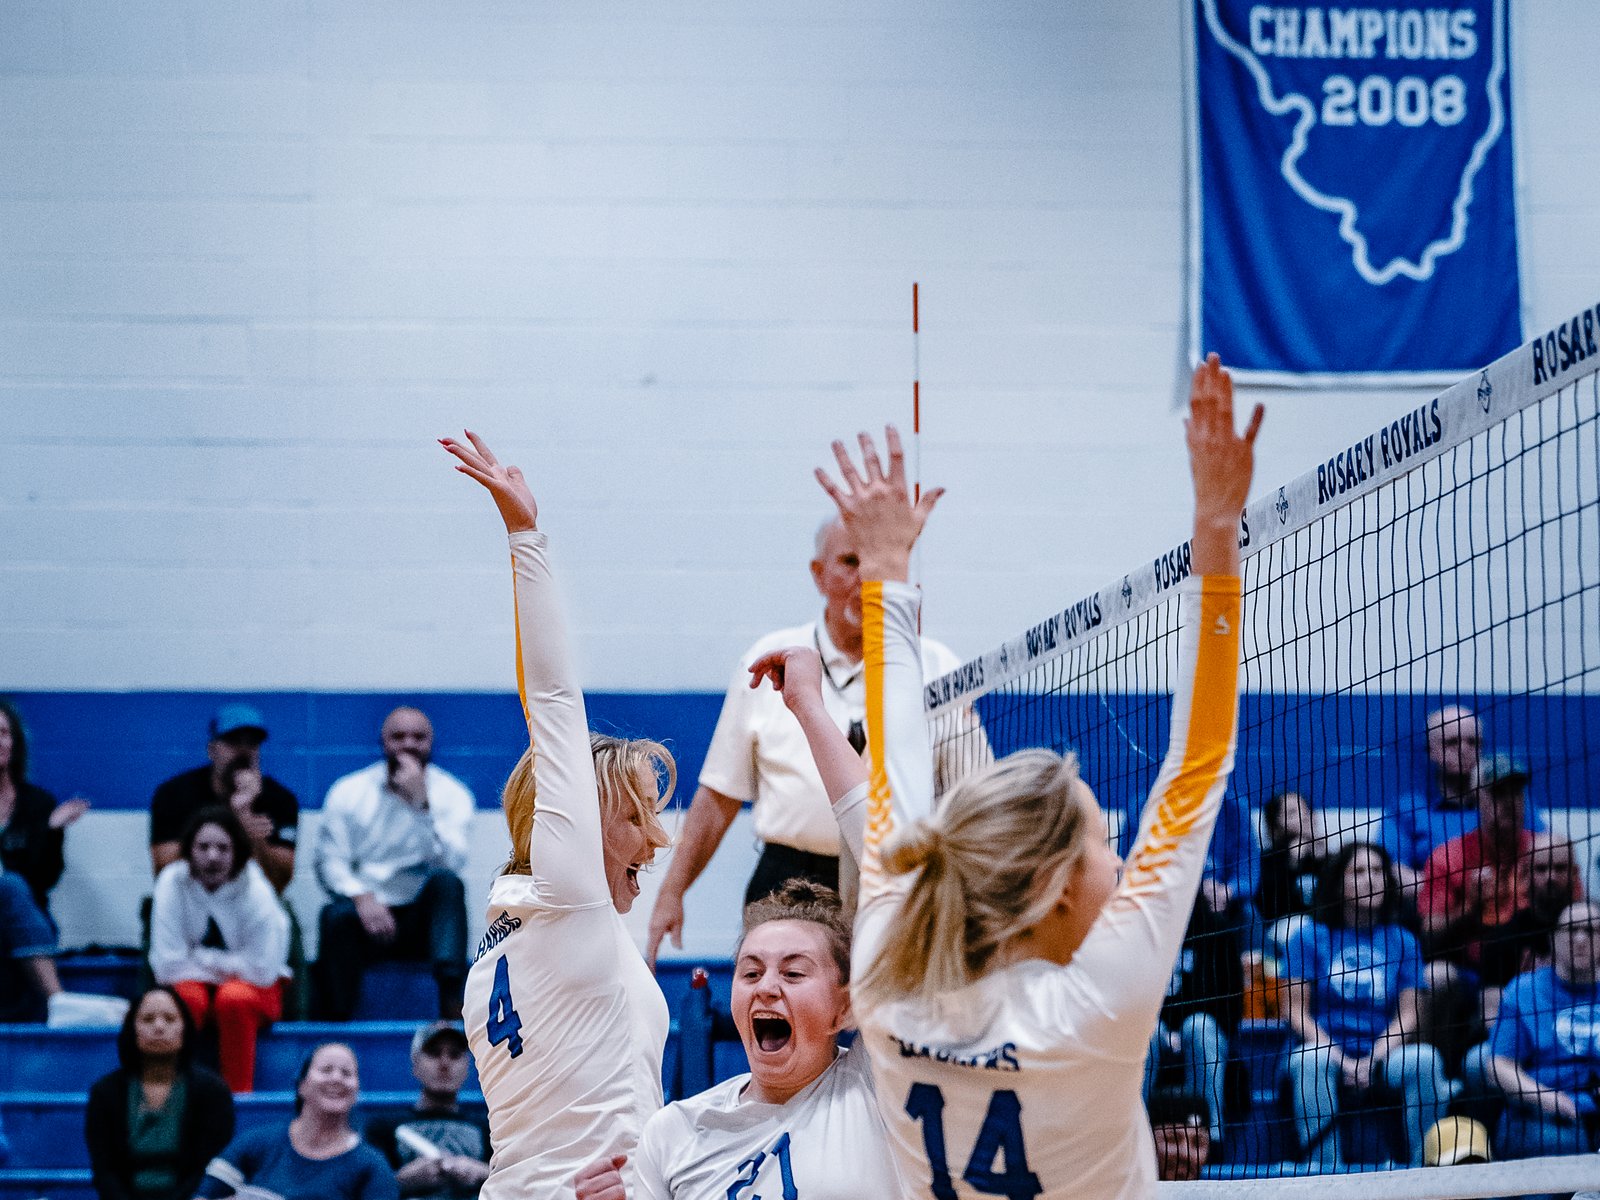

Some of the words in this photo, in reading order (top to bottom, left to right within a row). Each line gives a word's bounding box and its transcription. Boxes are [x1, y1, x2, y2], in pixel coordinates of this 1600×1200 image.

[1249, 6, 1477, 59] CHAMPIONS
[1321, 74, 1467, 126] 2008
[1532, 302, 1600, 386] ROSAR
[1317, 434, 1375, 504] ROSARY
[1381, 398, 1442, 469] ROYALS
[1154, 538, 1194, 594] ROSAR
[1025, 612, 1061, 661] ROSARY
[1064, 591, 1102, 639] ROYALS
[486, 953, 523, 1059] 4
